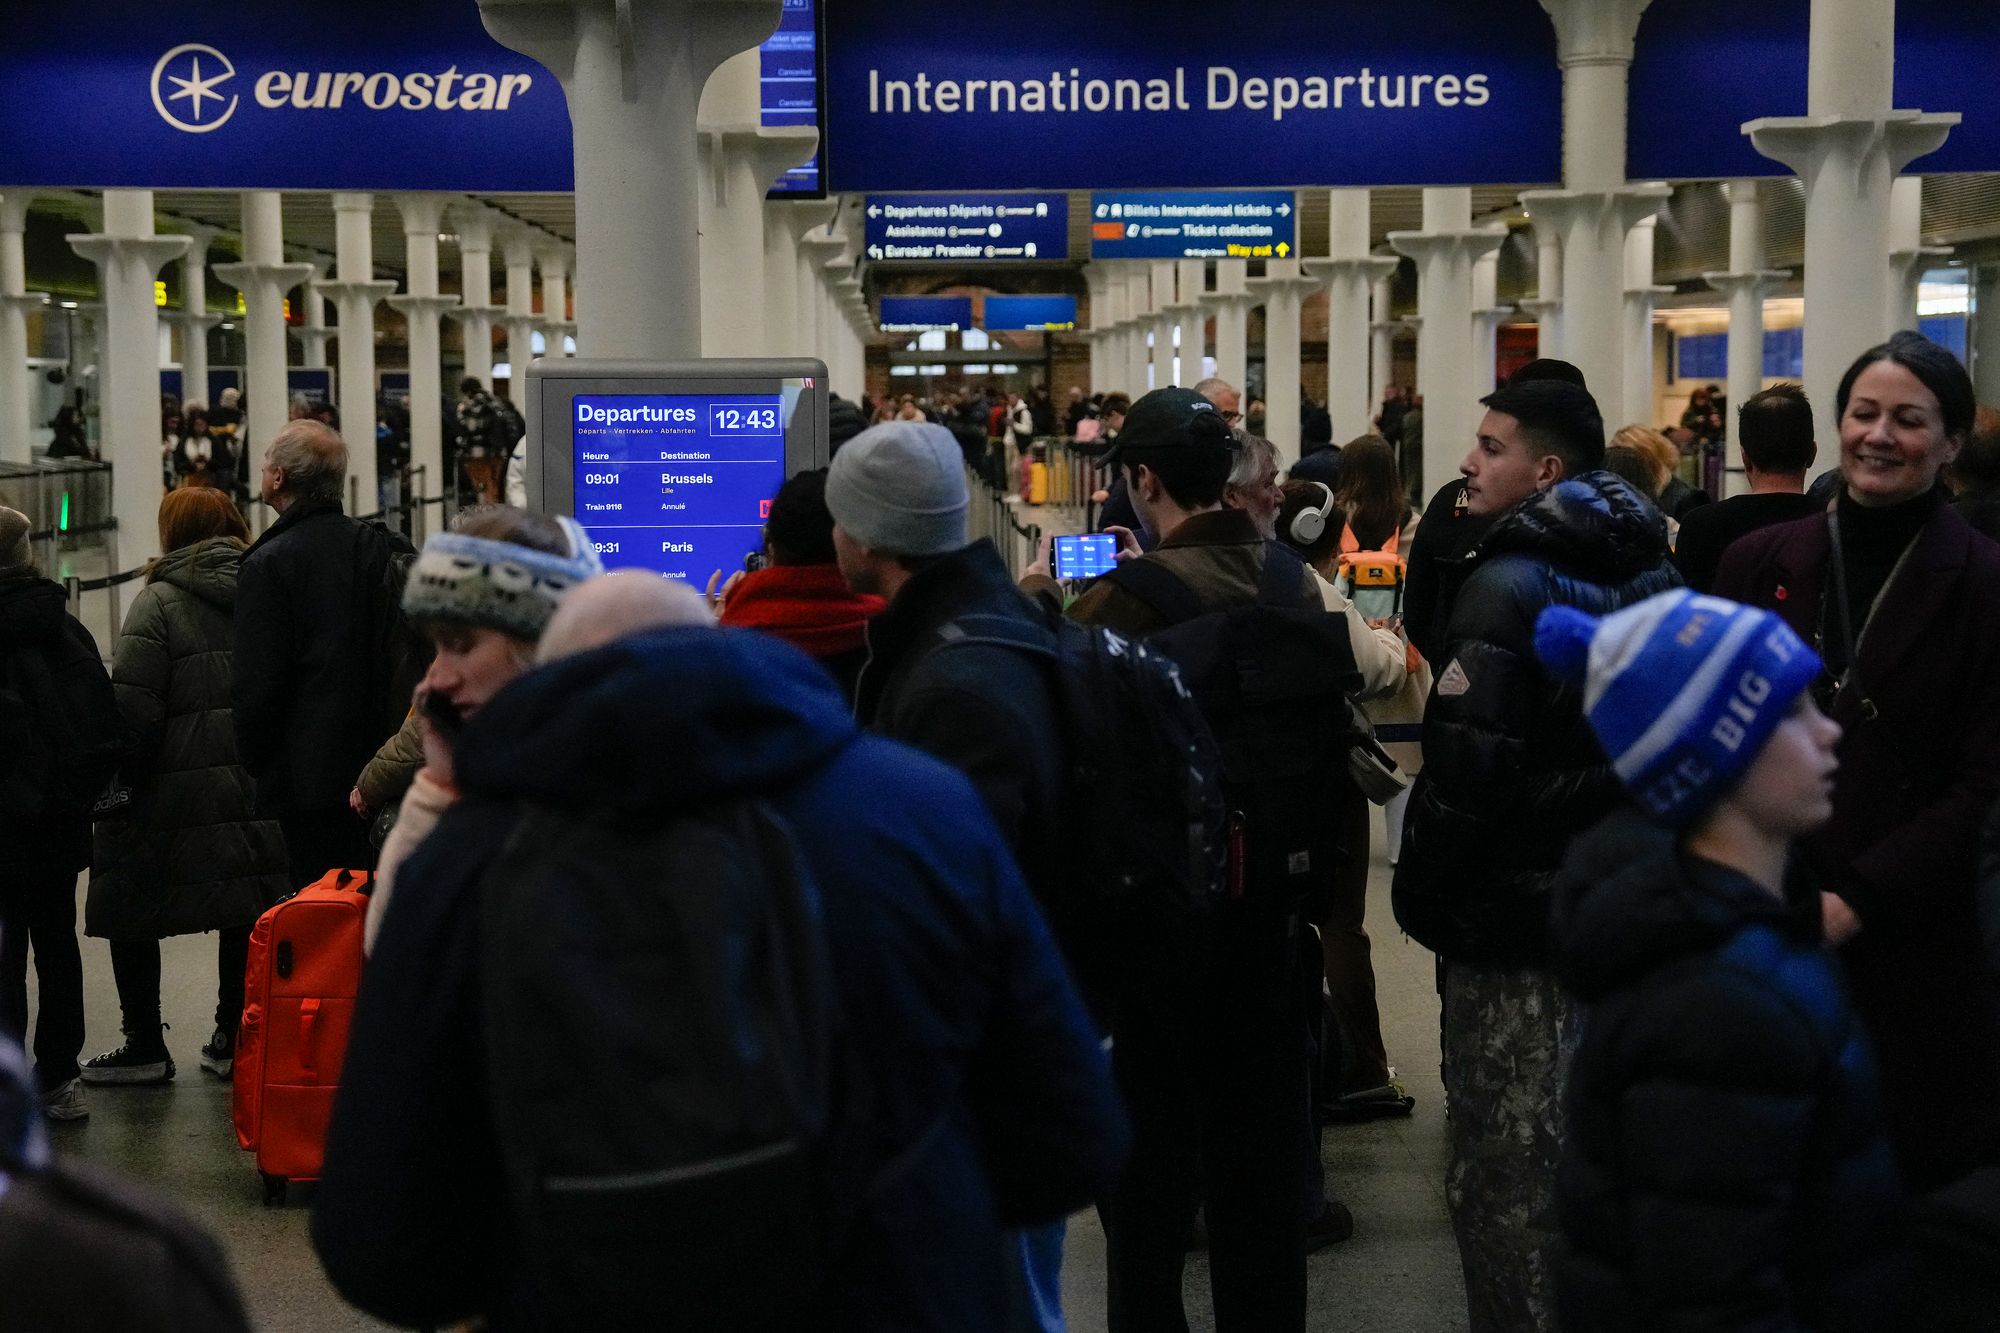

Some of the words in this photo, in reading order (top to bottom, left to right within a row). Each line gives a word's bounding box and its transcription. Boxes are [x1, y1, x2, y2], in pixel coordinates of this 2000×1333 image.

[254, 65, 532, 111] eurostar
[867, 67, 1190, 113] International
[1206, 66, 1491, 121] Departures
[884, 204, 948, 220] Departures
[949, 204, 994, 219] Départs
[1123, 204, 1160, 217] Billets
[1161, 203, 1233, 217] International
[1234, 203, 1273, 217] tickets
[885, 225, 947, 238] Assistance
[1182, 224, 1217, 237] Ticket
[1218, 224, 1273, 237] collection
[885, 244, 935, 258] Eurostar
[935, 244, 983, 258] Premier
[1227, 244, 1252, 258] Way
[1252, 245, 1273, 257] out
[578, 404, 697, 426] Departures
[715, 409, 776, 430] 12:43
[582, 452, 610, 460] Heure
[660, 451, 711, 460] Destination
[585, 473, 620, 485] 09:01
[661, 473, 714, 484] Brussels
[585, 503, 605, 511] Train
[605, 503, 622, 511] 9116
[661, 502, 686, 510] Annulé
[662, 541, 694, 552] Paris
[1711, 670, 1772, 752] BIG
